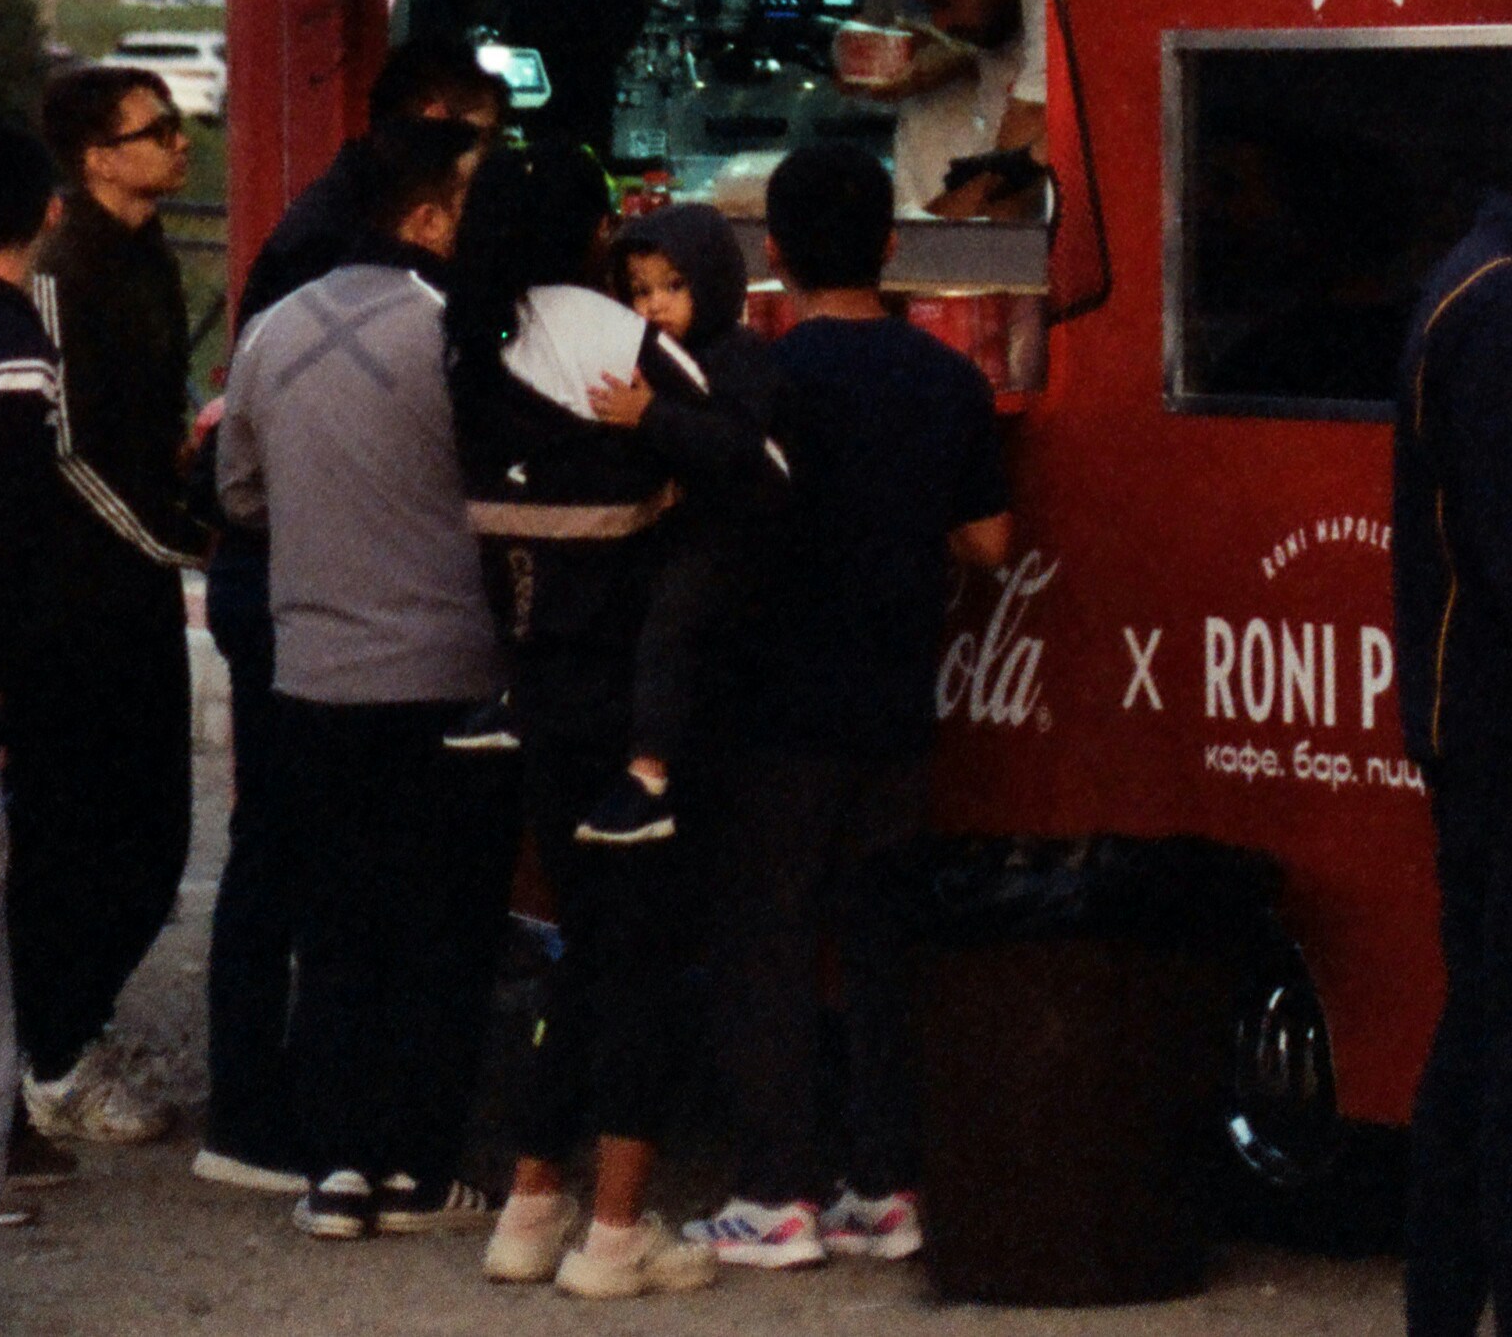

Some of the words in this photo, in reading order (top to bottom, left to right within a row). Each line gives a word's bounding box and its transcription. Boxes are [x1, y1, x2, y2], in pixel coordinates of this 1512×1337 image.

[1261, 527, 1307, 580] RONI
[1315, 515, 1392, 551] NAPOLE
[1203, 616, 1338, 728] RONI
[1204, 739, 1285, 783] кафе.
[1293, 740, 1358, 792] бар.
[1366, 756, 1426, 797] пиц
